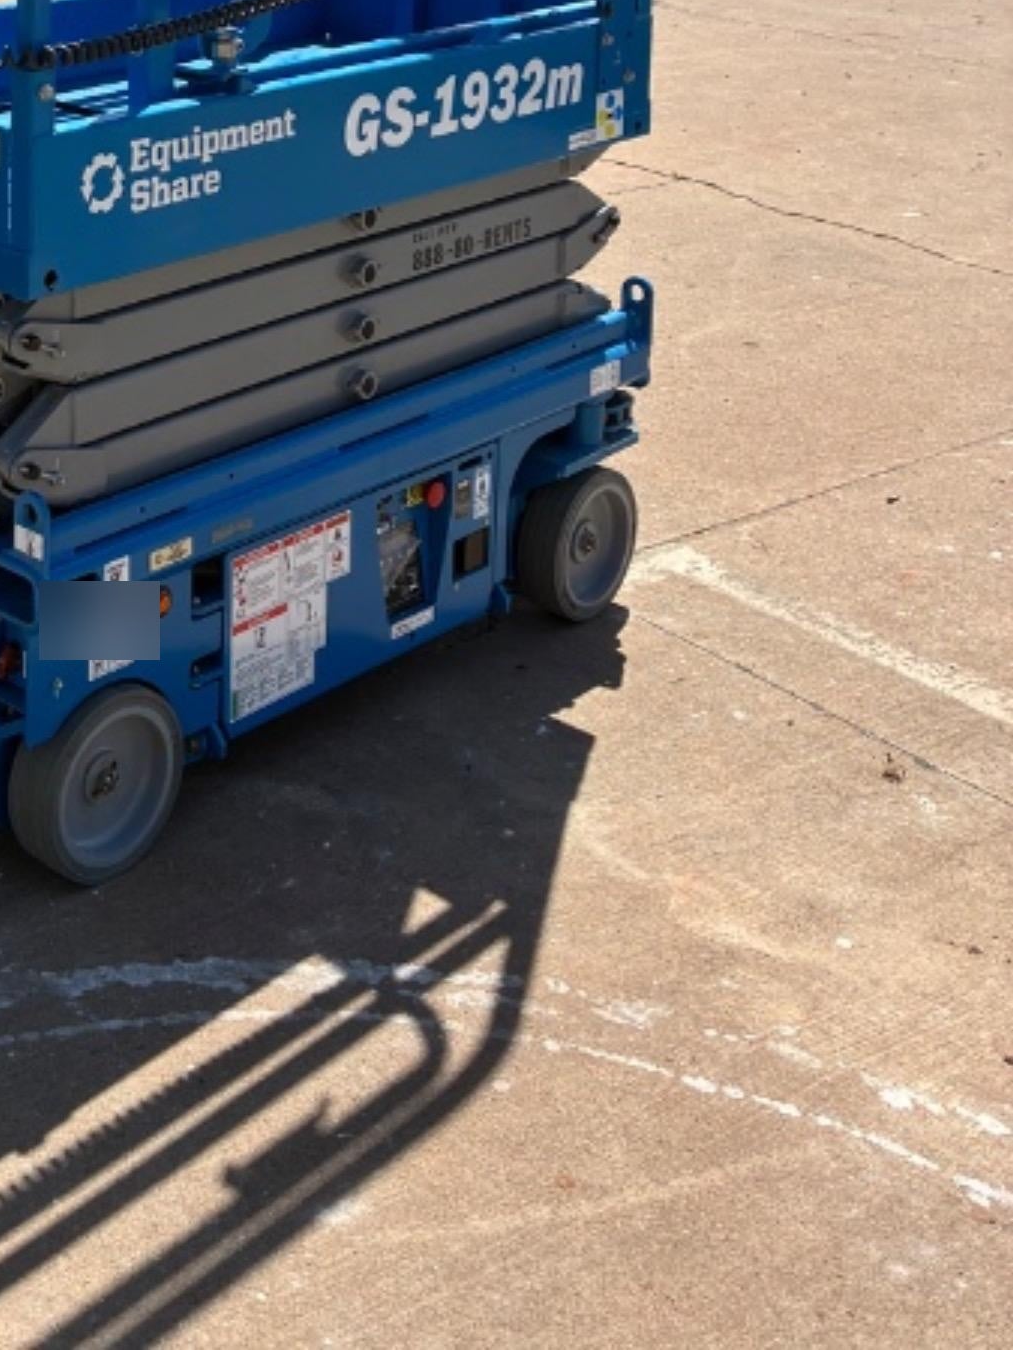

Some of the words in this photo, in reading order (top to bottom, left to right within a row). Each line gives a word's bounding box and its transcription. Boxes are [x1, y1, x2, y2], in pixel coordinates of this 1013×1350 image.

[344, 57, 584, 157] GS-1932m
[130, 108, 297, 173] Equipment
[130, 169, 222, 213] Share
